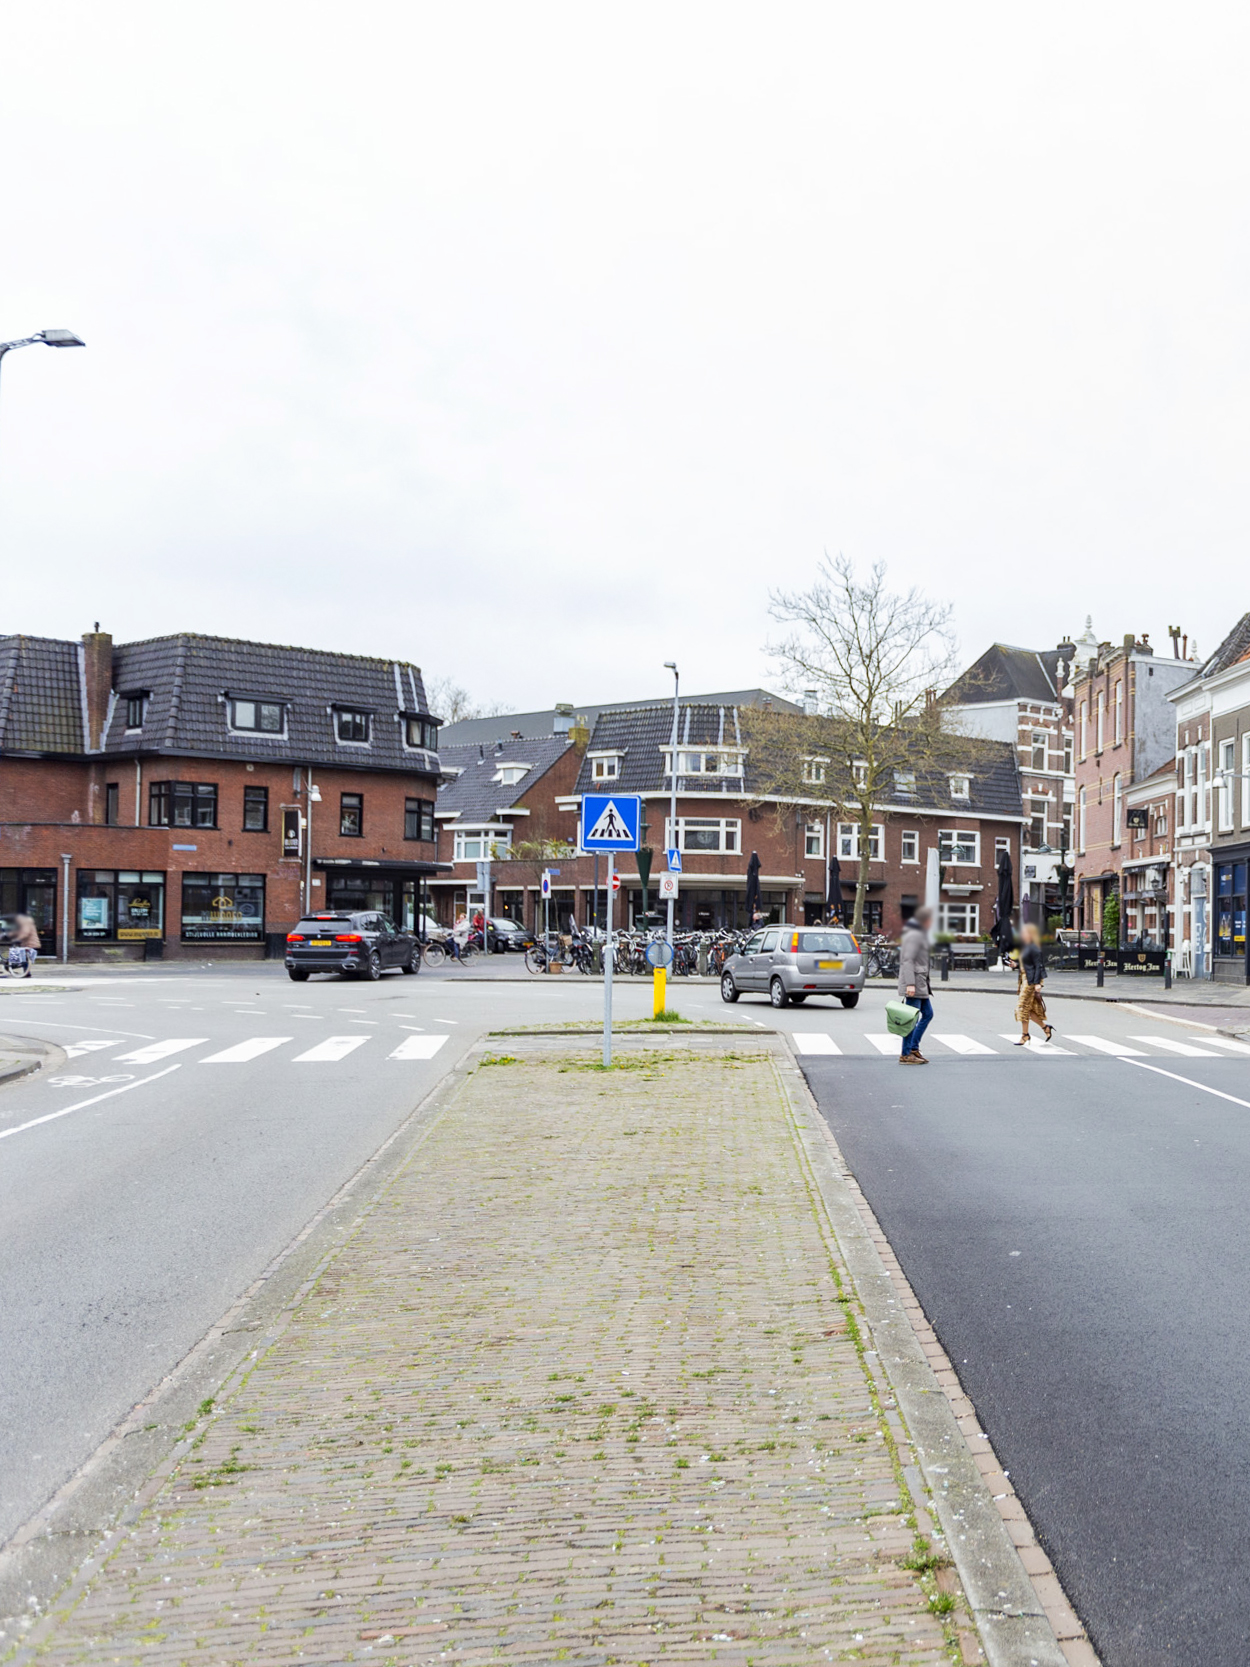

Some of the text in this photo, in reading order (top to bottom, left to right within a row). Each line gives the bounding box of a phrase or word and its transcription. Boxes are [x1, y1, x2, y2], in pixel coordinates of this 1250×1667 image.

[1084, 959, 1118, 968] Hert Jan
[1123, 962, 1160, 972] Hertog Jan
